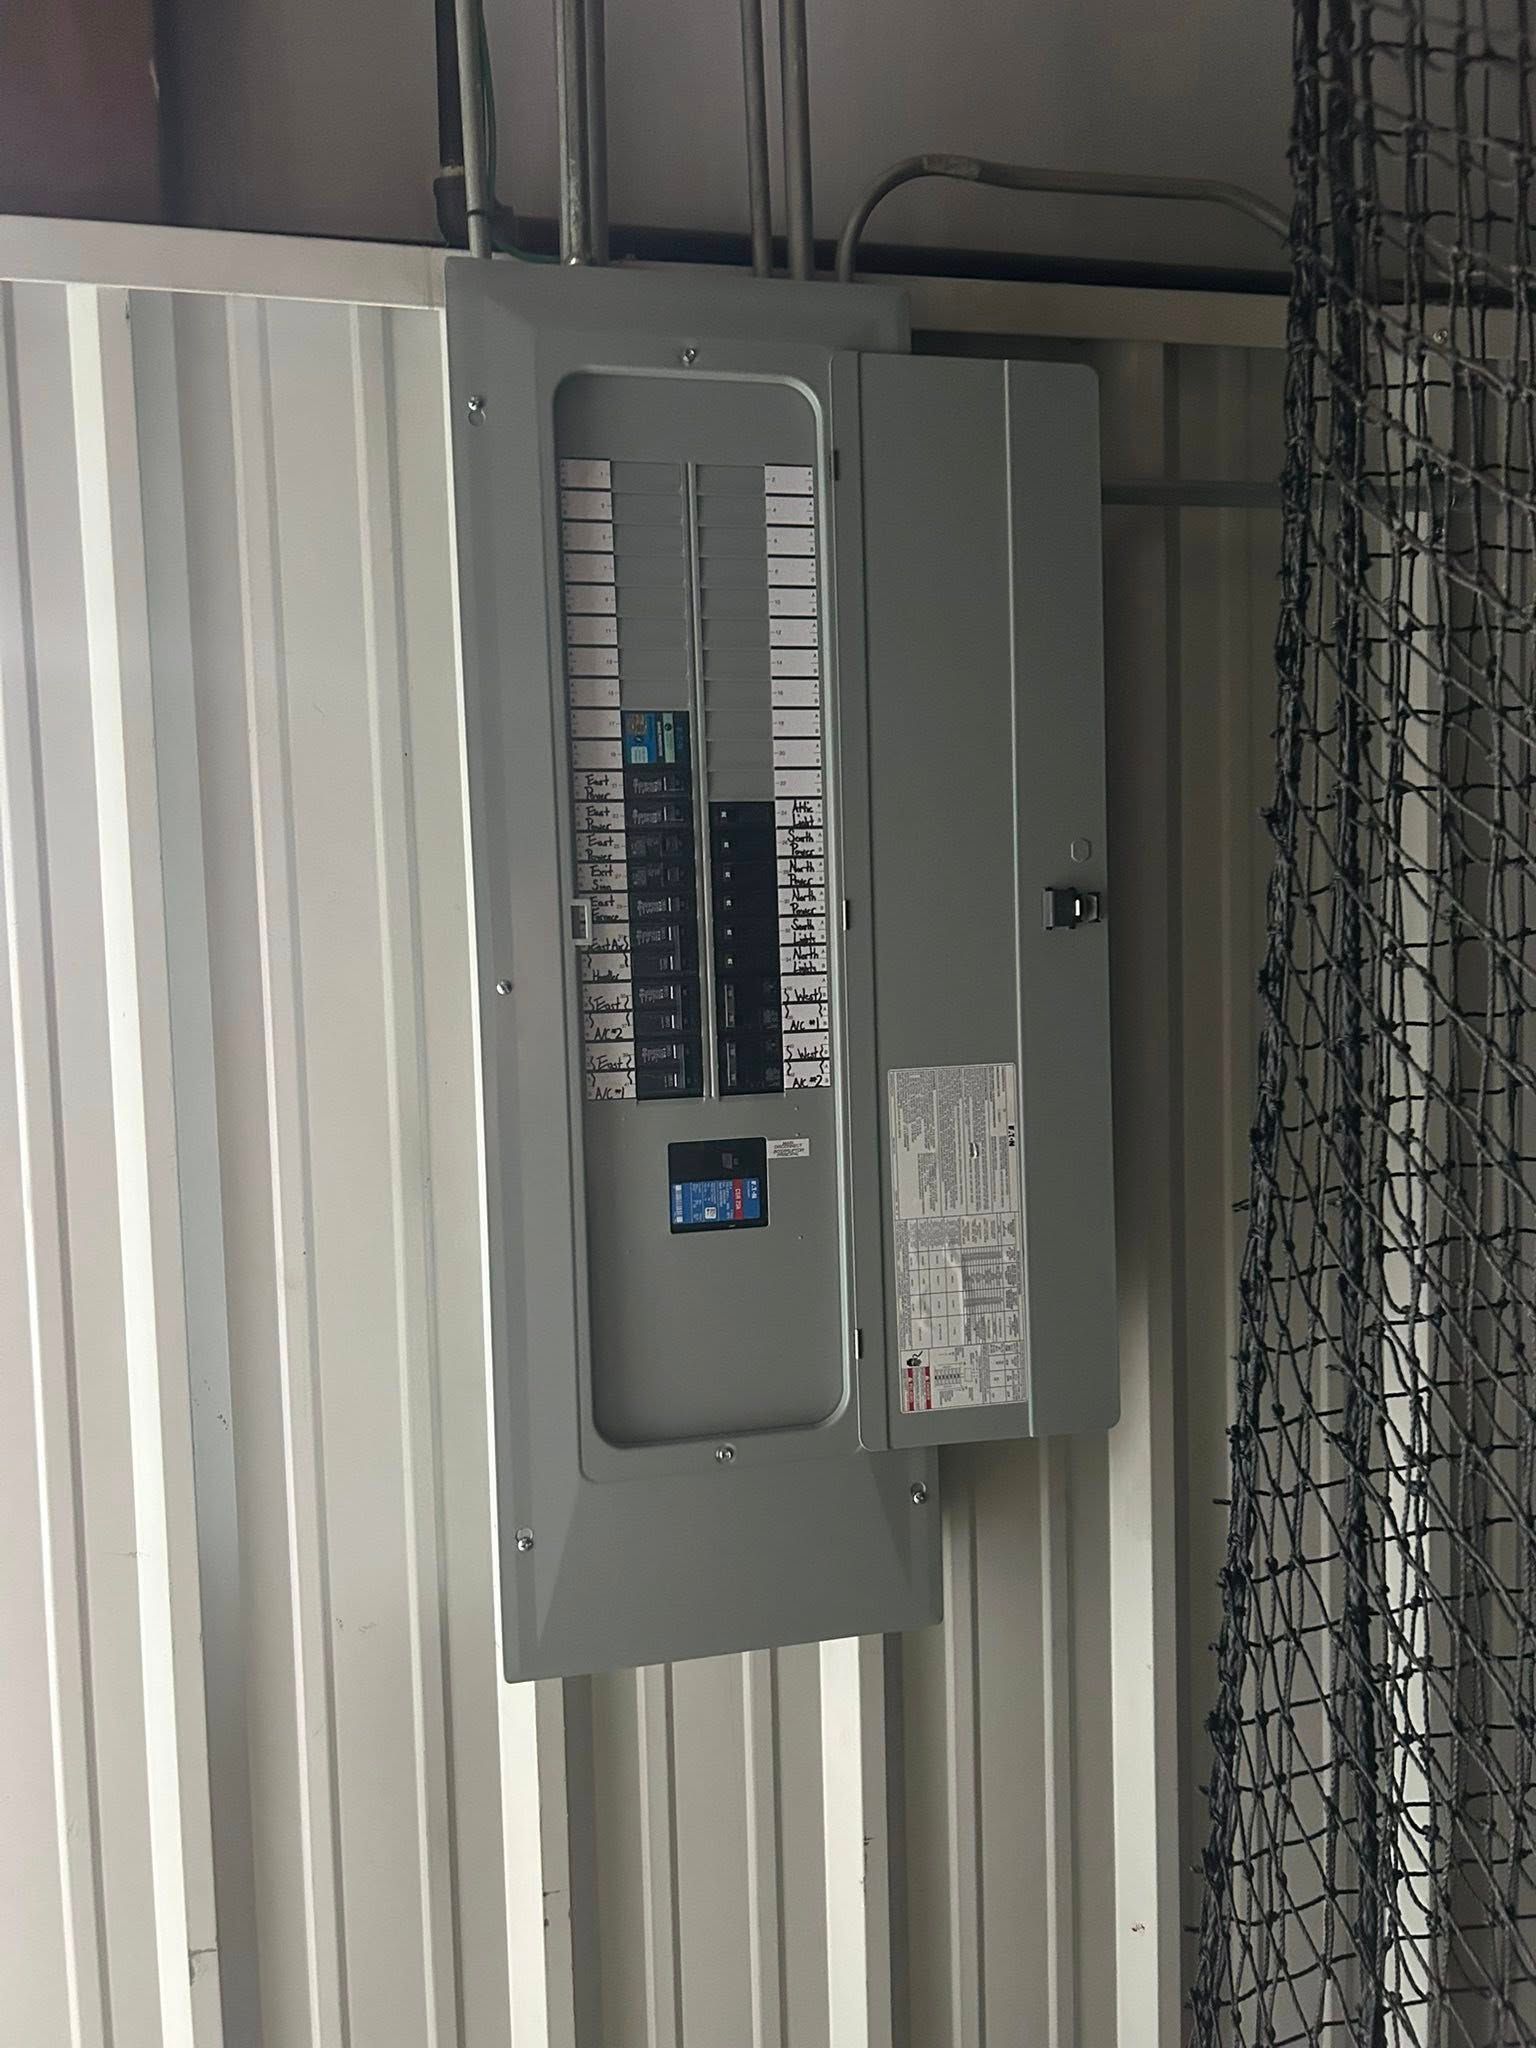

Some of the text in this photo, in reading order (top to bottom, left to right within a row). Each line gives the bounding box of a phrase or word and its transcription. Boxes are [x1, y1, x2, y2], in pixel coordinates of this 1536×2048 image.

[585, 774, 609, 786] East
[586, 806, 610, 816] East
[586, 834, 614, 846] East
[590, 864, 613, 877] Exit
[790, 858, 815, 872] North
[792, 888, 816, 901] North
[591, 895, 615, 907] East
[790, 902, 816, 915] Power
[791, 919, 815, 930] South
[793, 946, 818, 960] North
[794, 988, 818, 1000] West
[594, 996, 621, 1011] East
[797, 1046, 818, 1058] West
[596, 1055, 623, 1070] East
